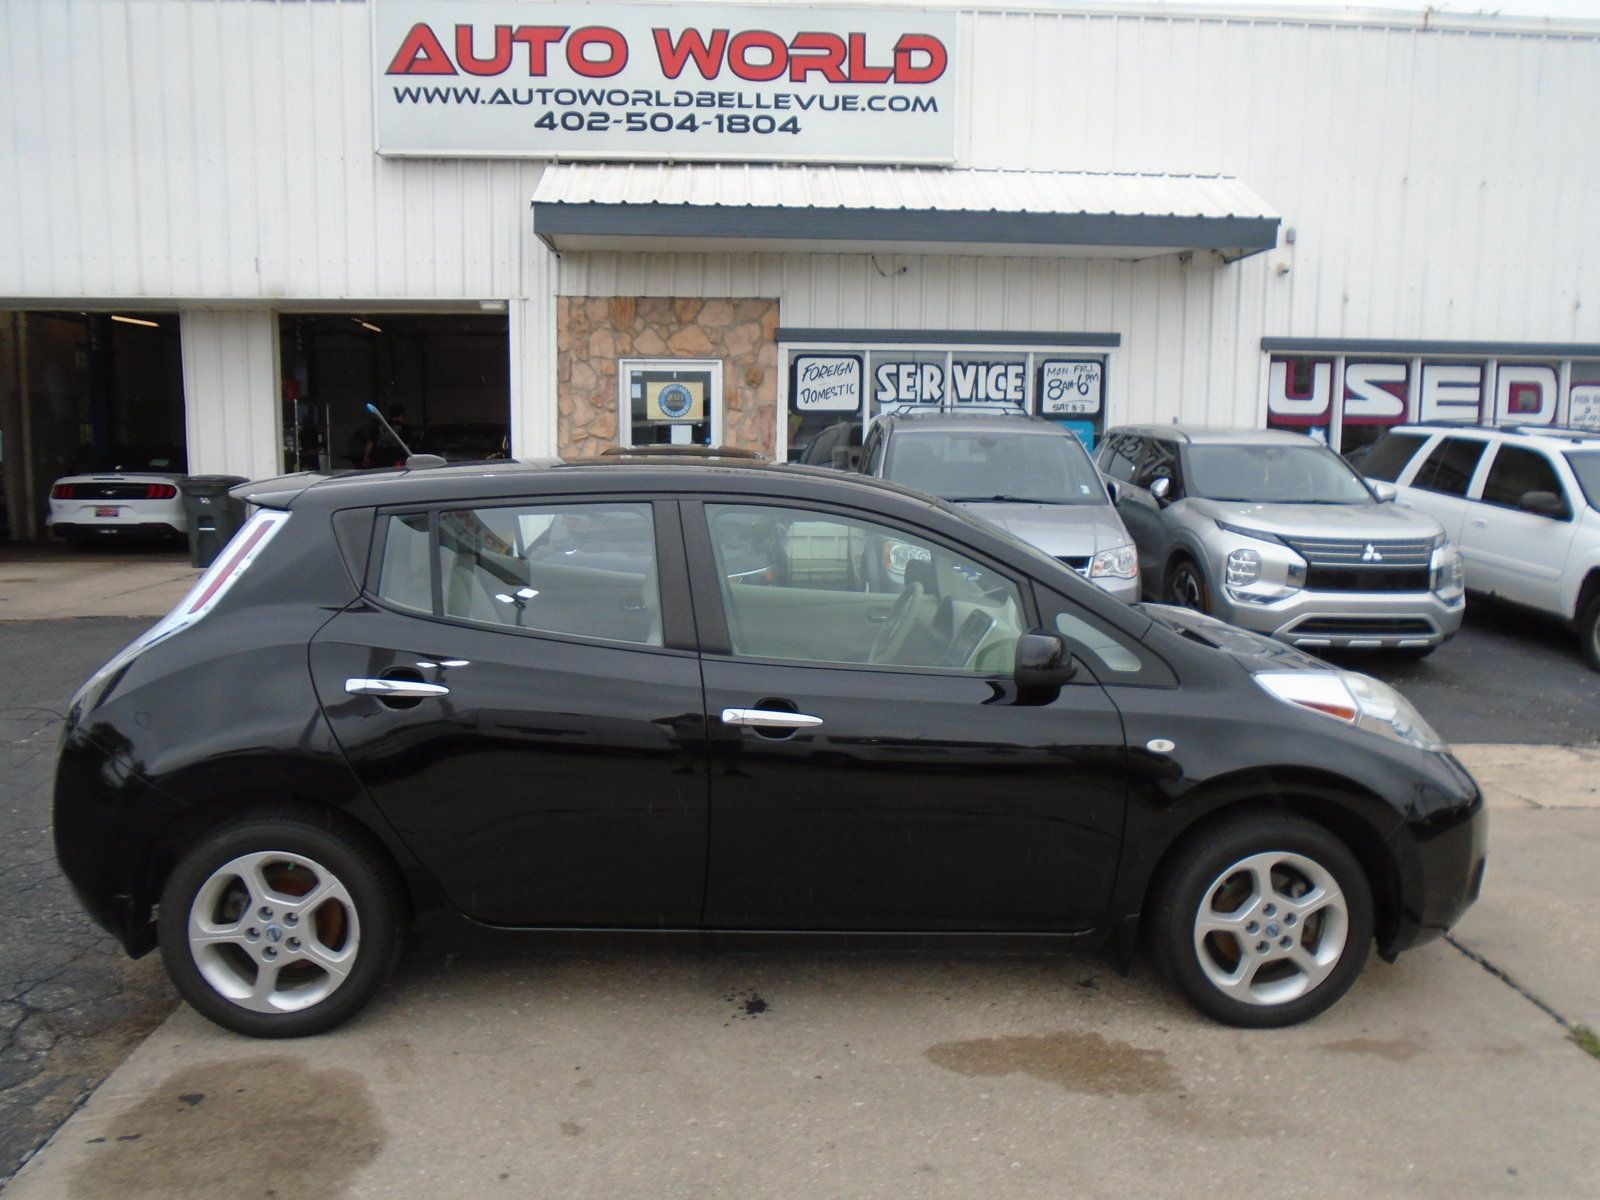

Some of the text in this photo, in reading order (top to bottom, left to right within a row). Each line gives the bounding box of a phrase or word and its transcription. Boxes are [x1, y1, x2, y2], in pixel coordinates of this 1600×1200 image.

[384, 22, 948, 84] AUTO WORLD
[393, 86, 939, 112] WWW.AUTOWORLDBELLEVUE.COM
[534, 110, 802, 135] 402-504-1804
[801, 361, 855, 381] FOREIGN
[875, 362, 1026, 402] SERVICE
[1046, 366, 1069, 376] MON
[800, 383, 856, 404] DOMESTIC
[1267, 361, 1559, 425] USED
